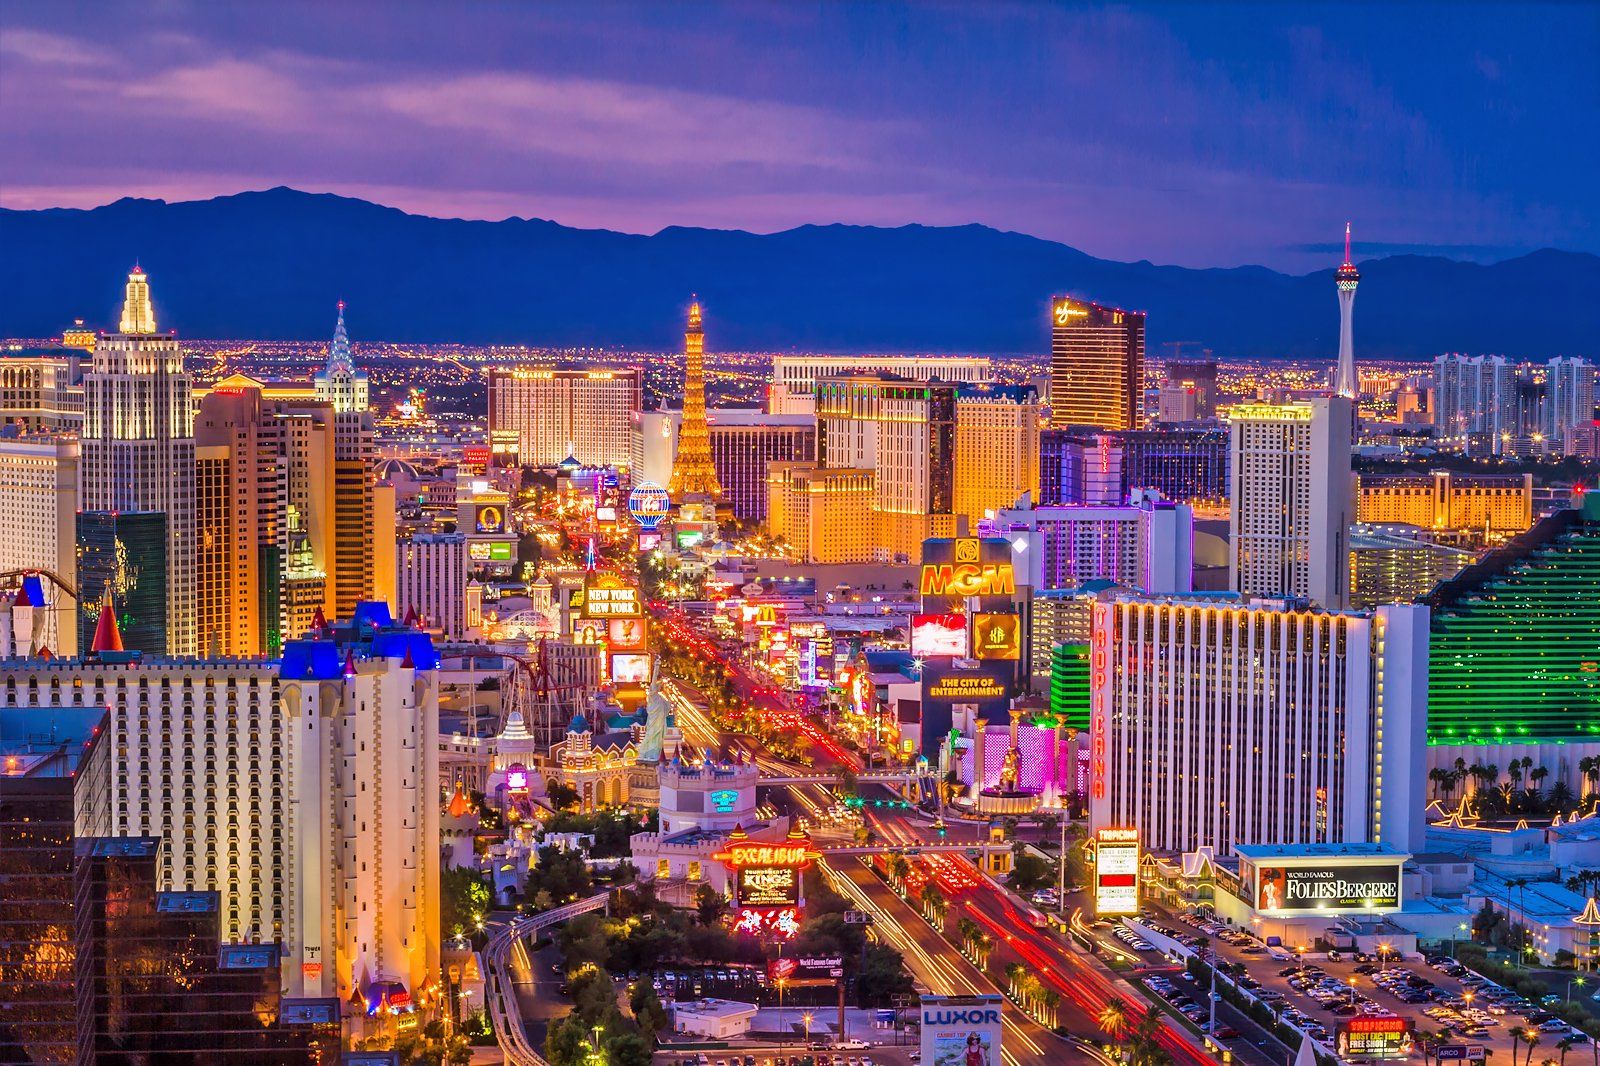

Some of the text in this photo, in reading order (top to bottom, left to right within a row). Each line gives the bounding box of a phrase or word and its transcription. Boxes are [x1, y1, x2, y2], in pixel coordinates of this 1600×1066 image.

[920, 564, 1015, 596] MGM
[588, 589, 610, 601] NEW
[609, 589, 635, 601] YORK
[588, 602, 635, 613] NEW YORK
[941, 678, 994, 687] THE CITY OF
[930, 687, 1004, 696] ENTERTAINMENT
[1092, 597, 1106, 800] TROPICANA
[1099, 829, 1138, 840] TROPICANA
[732, 847, 806, 865] EXCALIBUR
[744, 874, 793, 886] KINGS
[924, 1010, 1001, 1025] LUXOR
[1351, 1020, 1403, 1031] TROPICANA
[1350, 1032, 1369, 1041] MOST
[1350, 1040, 1365, 1048] FREE
